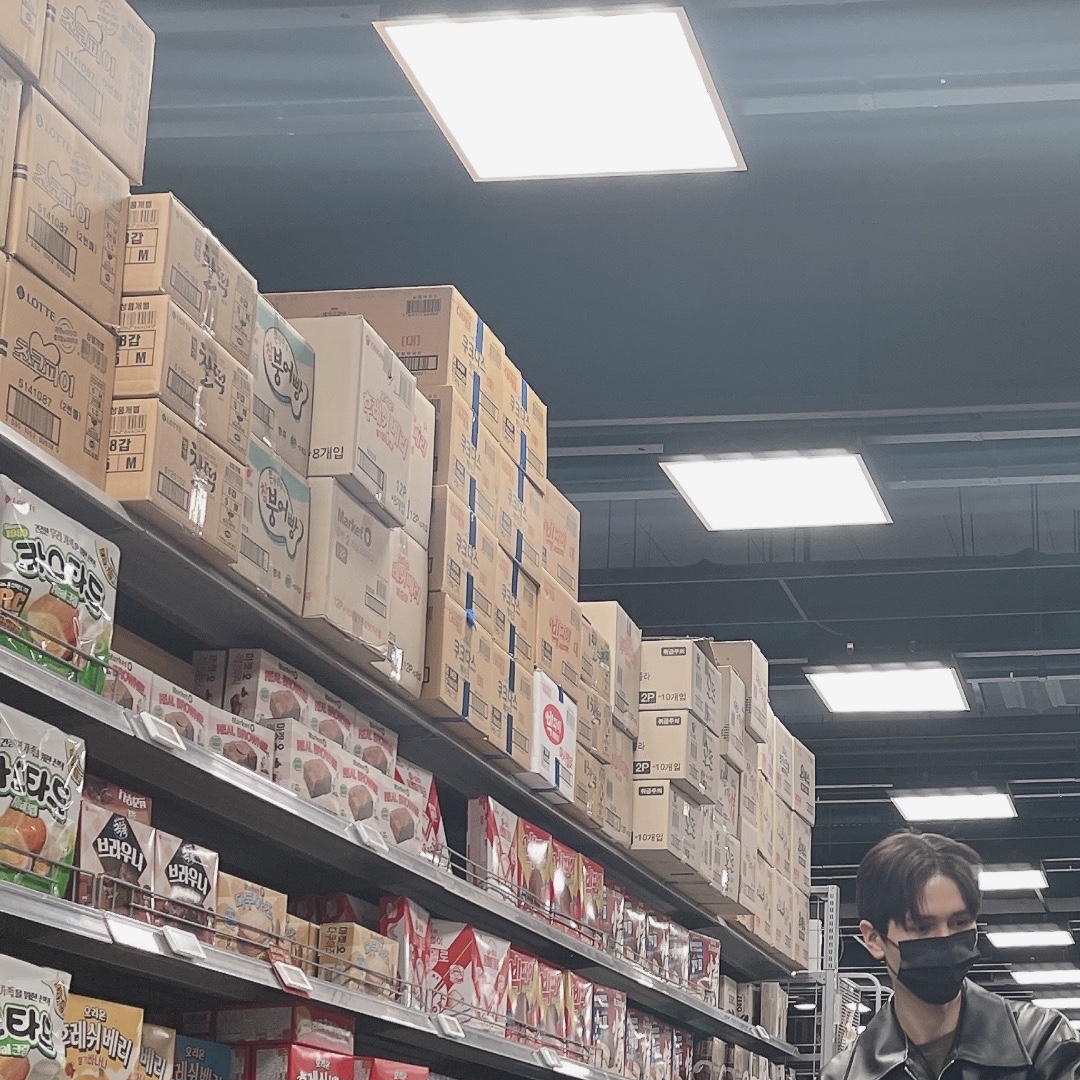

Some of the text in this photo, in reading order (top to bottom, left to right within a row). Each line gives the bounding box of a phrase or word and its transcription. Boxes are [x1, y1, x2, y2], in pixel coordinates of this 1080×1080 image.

[138, 249, 149, 261] M
[26, 294, 56, 322] LOTTE
[12, 336, 75, 398] 초코파이
[136, 352, 146, 364] M
[19, 378, 53, 406] 5141087
[126, 456, 137, 469] M
[640, 693, 656, 704] 2P
[635, 763, 650, 773] 2P
[95, 836, 147, 874] 브라우니
[168, 863, 209, 896] 브라우니
